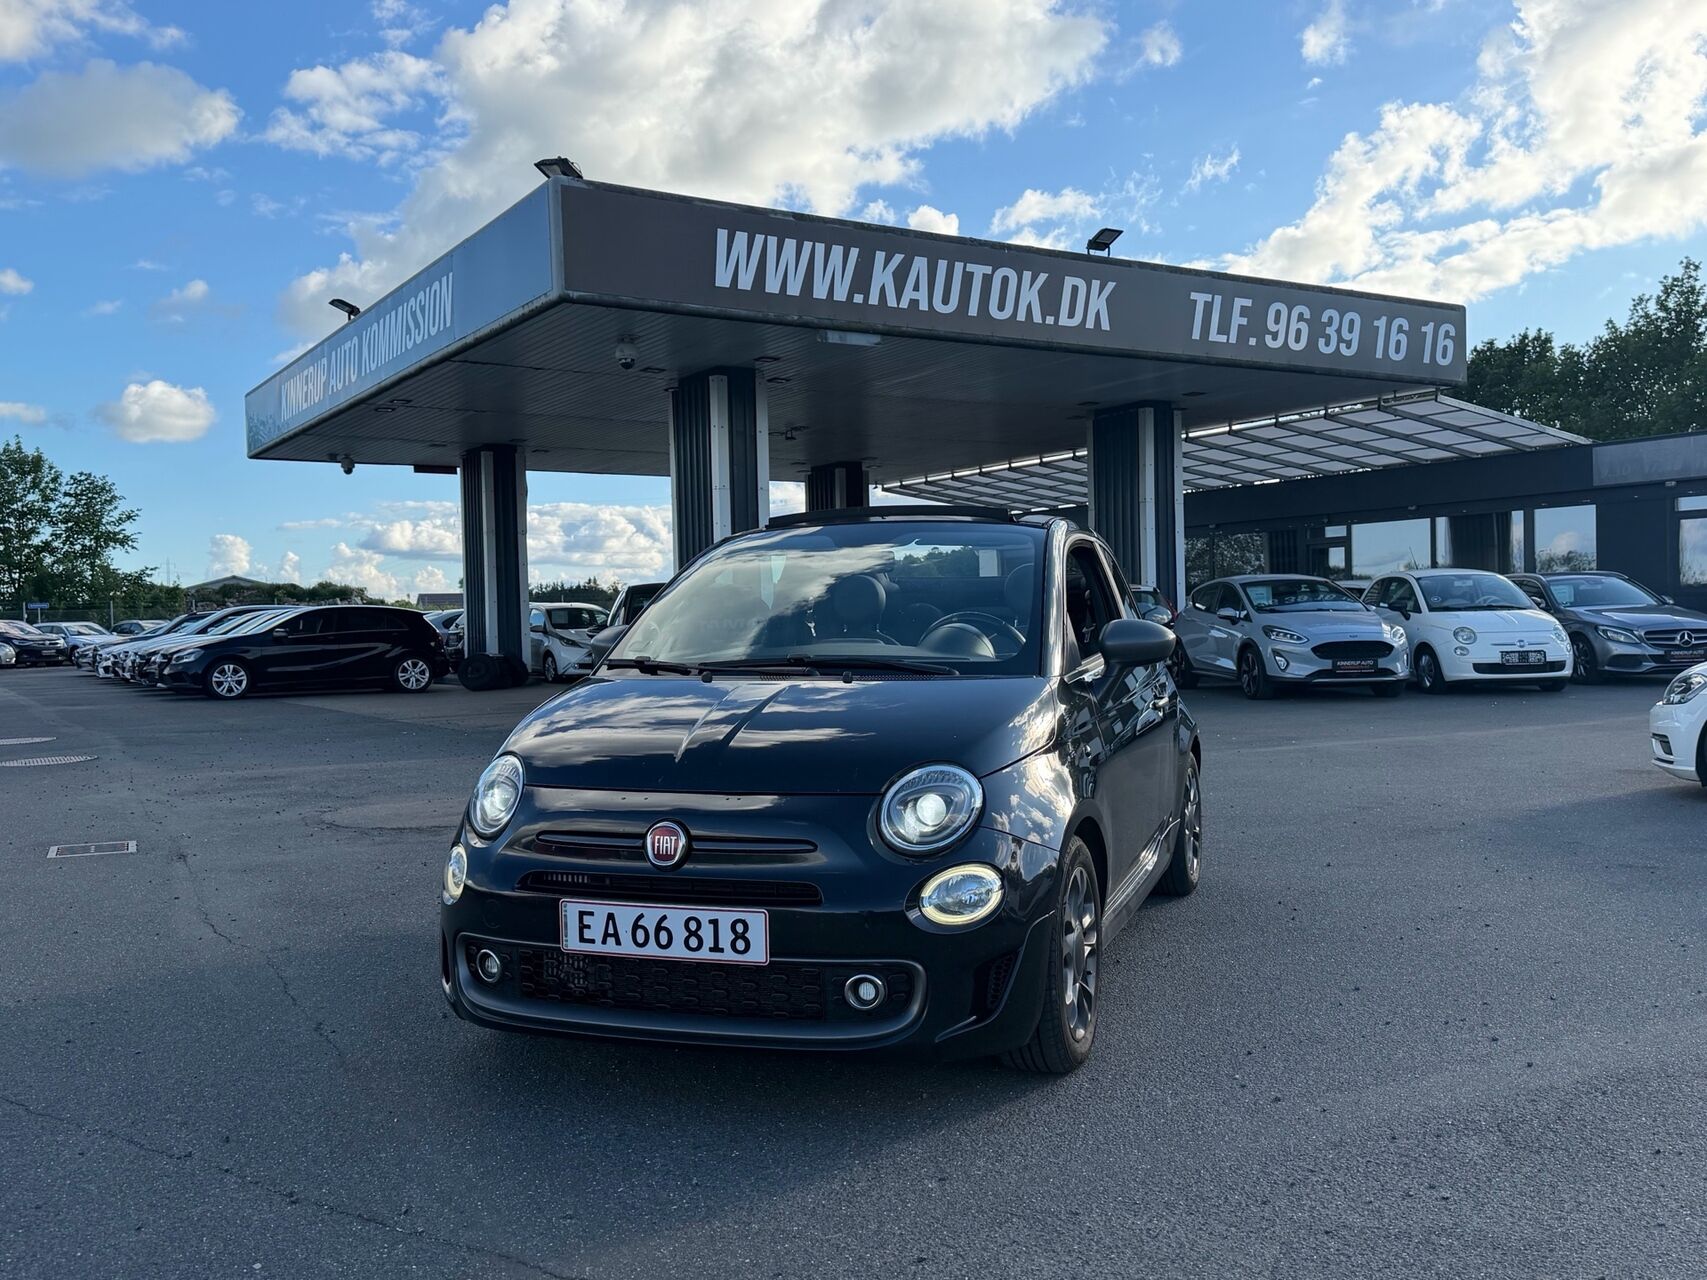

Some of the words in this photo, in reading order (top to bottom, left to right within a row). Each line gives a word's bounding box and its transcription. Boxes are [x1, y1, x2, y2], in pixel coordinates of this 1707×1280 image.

[715, 228, 1117, 331] WWW.KAUTOK.DK
[281, 356, 328, 422] KINNERUP
[329, 336, 359, 395] AUTO
[361, 272, 453, 377] KOMMISSION
[1190, 291, 1257, 346] TLF.
[1264, 302, 1311, 351] 96
[1318, 308, 1361, 357] 39
[1372, 315, 1410, 361] 16
[1420, 322, 1456, 366] 16
[654, 835, 677, 855] FIAT
